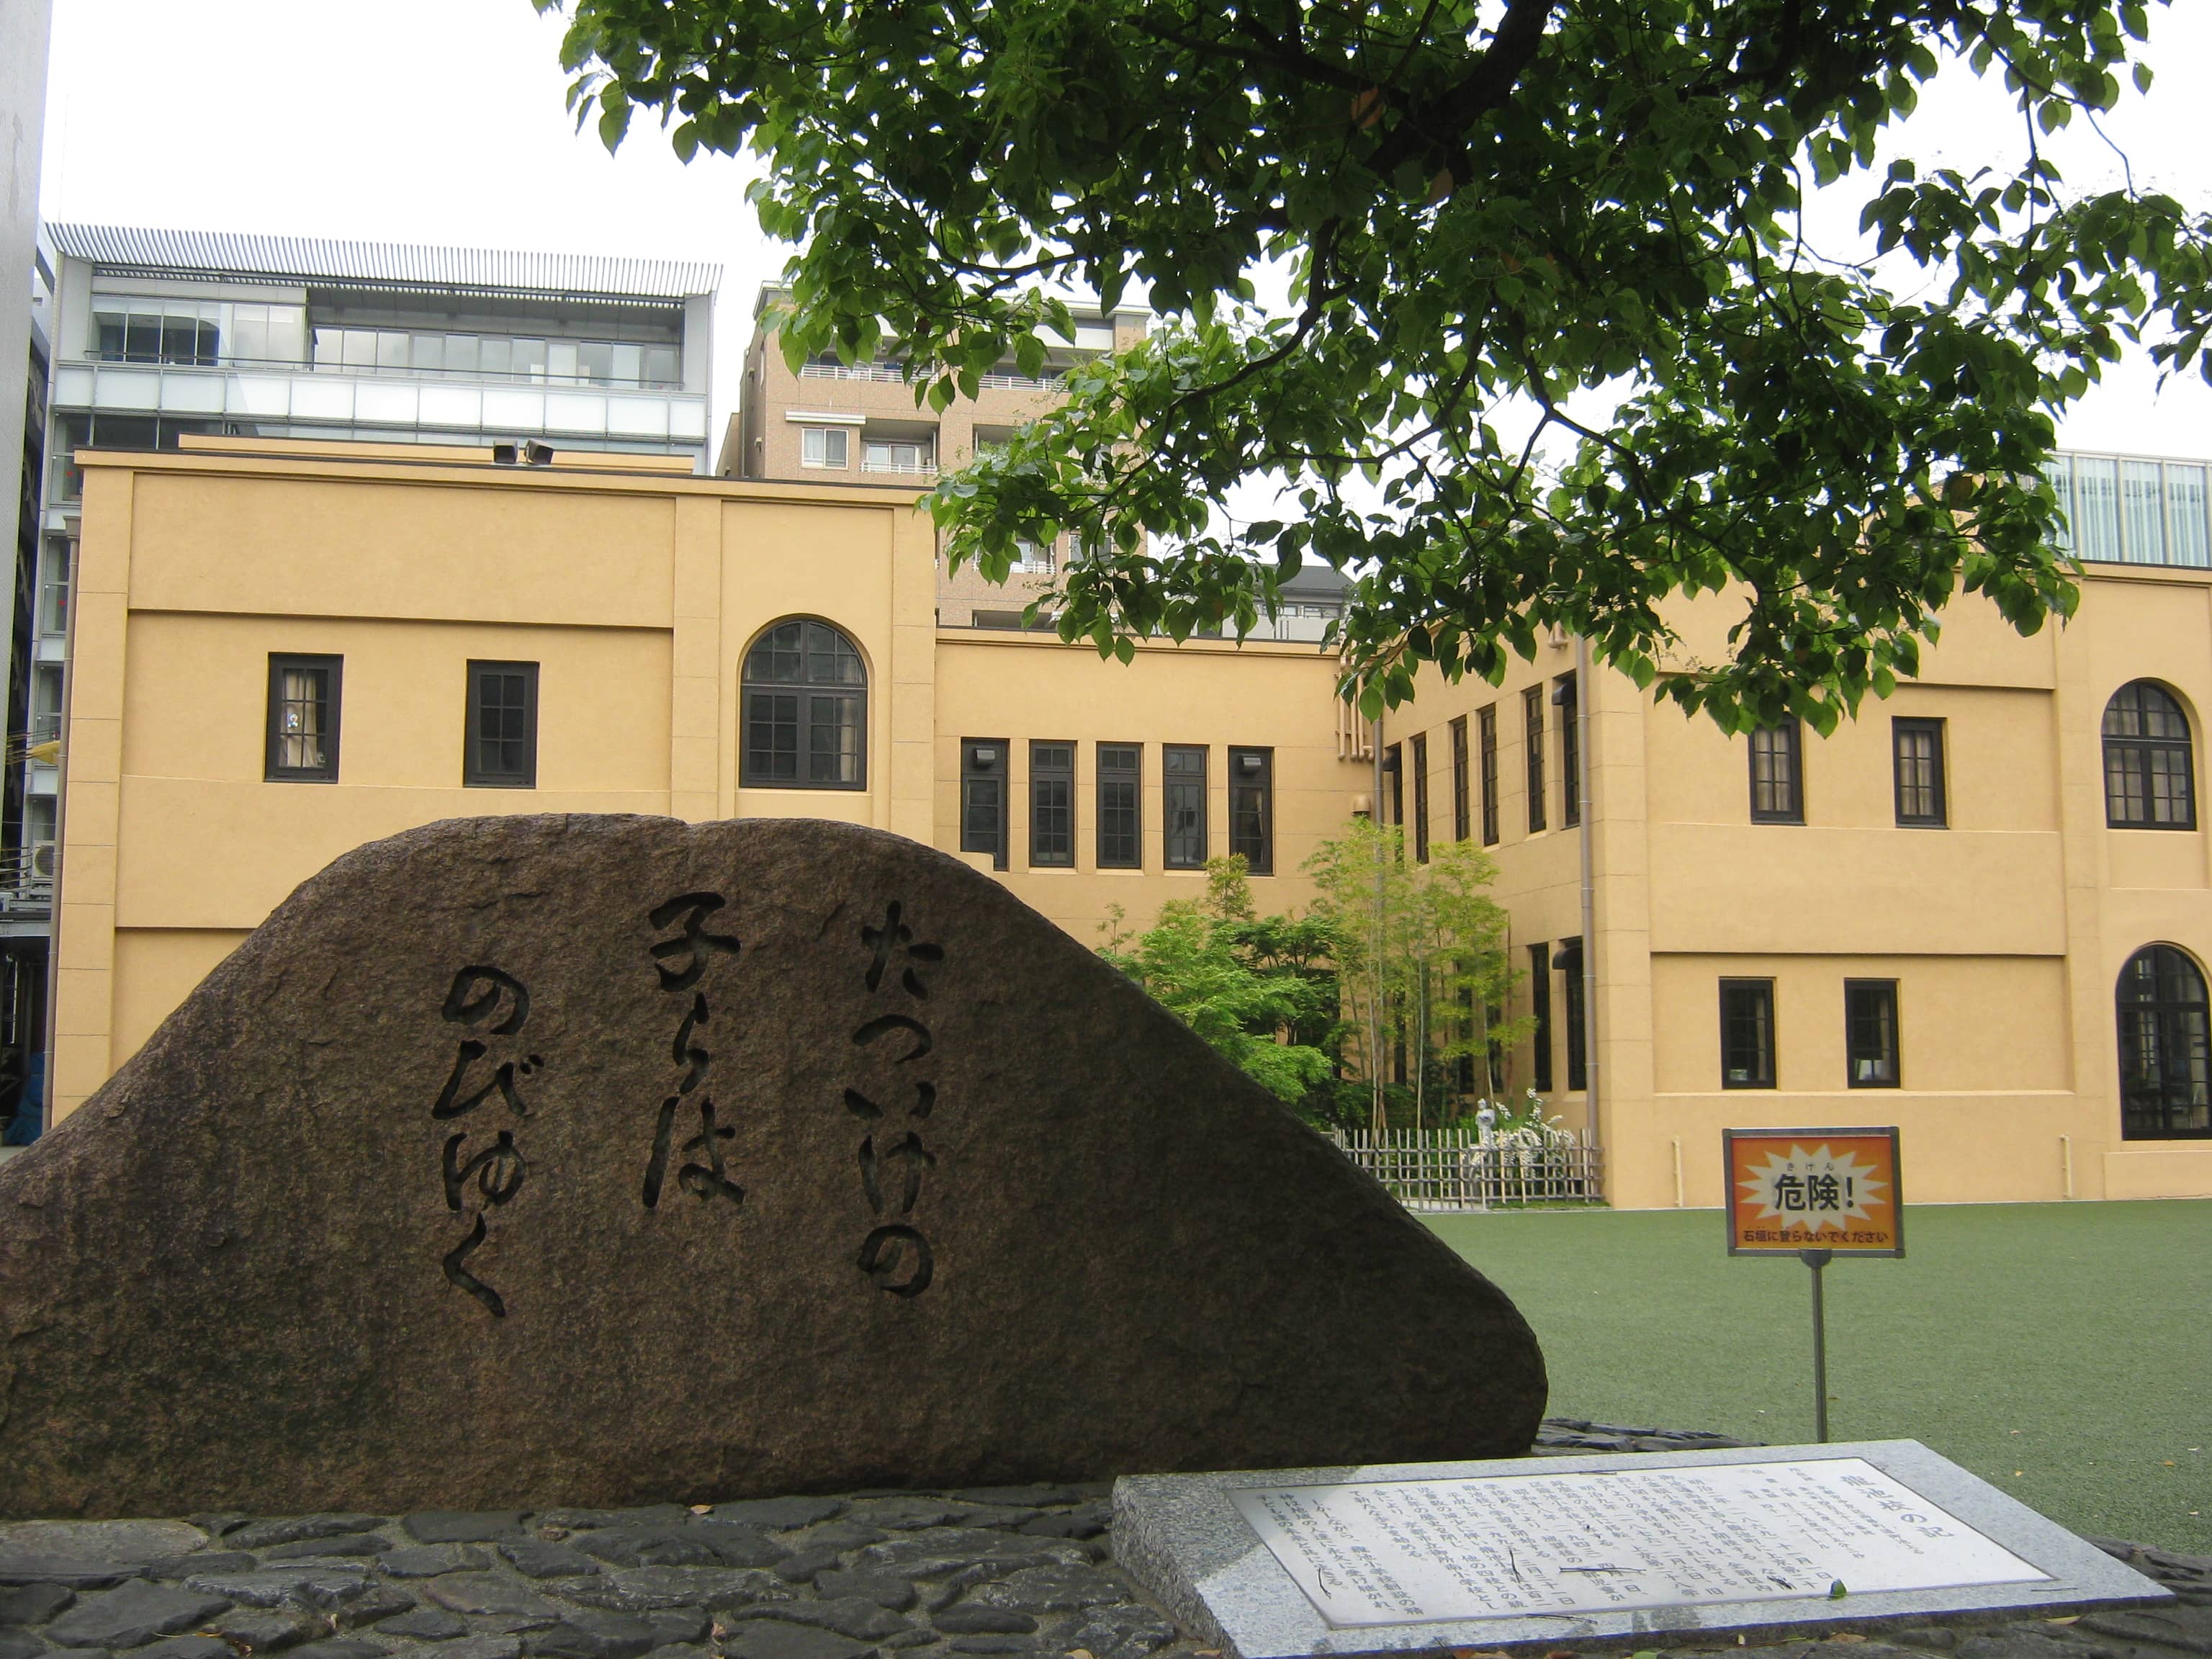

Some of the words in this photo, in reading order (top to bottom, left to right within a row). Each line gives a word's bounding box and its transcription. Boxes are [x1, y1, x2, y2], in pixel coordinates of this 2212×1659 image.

[431, 964, 545, 1318] のびゆく
[642, 891, 745, 1210] 子らは
[842, 899, 945, 1298] たついけの
[1773, 1173, 1854, 1212] 危険!
[1743, 1230, 1889, 1244] 石垣に登らないでください
